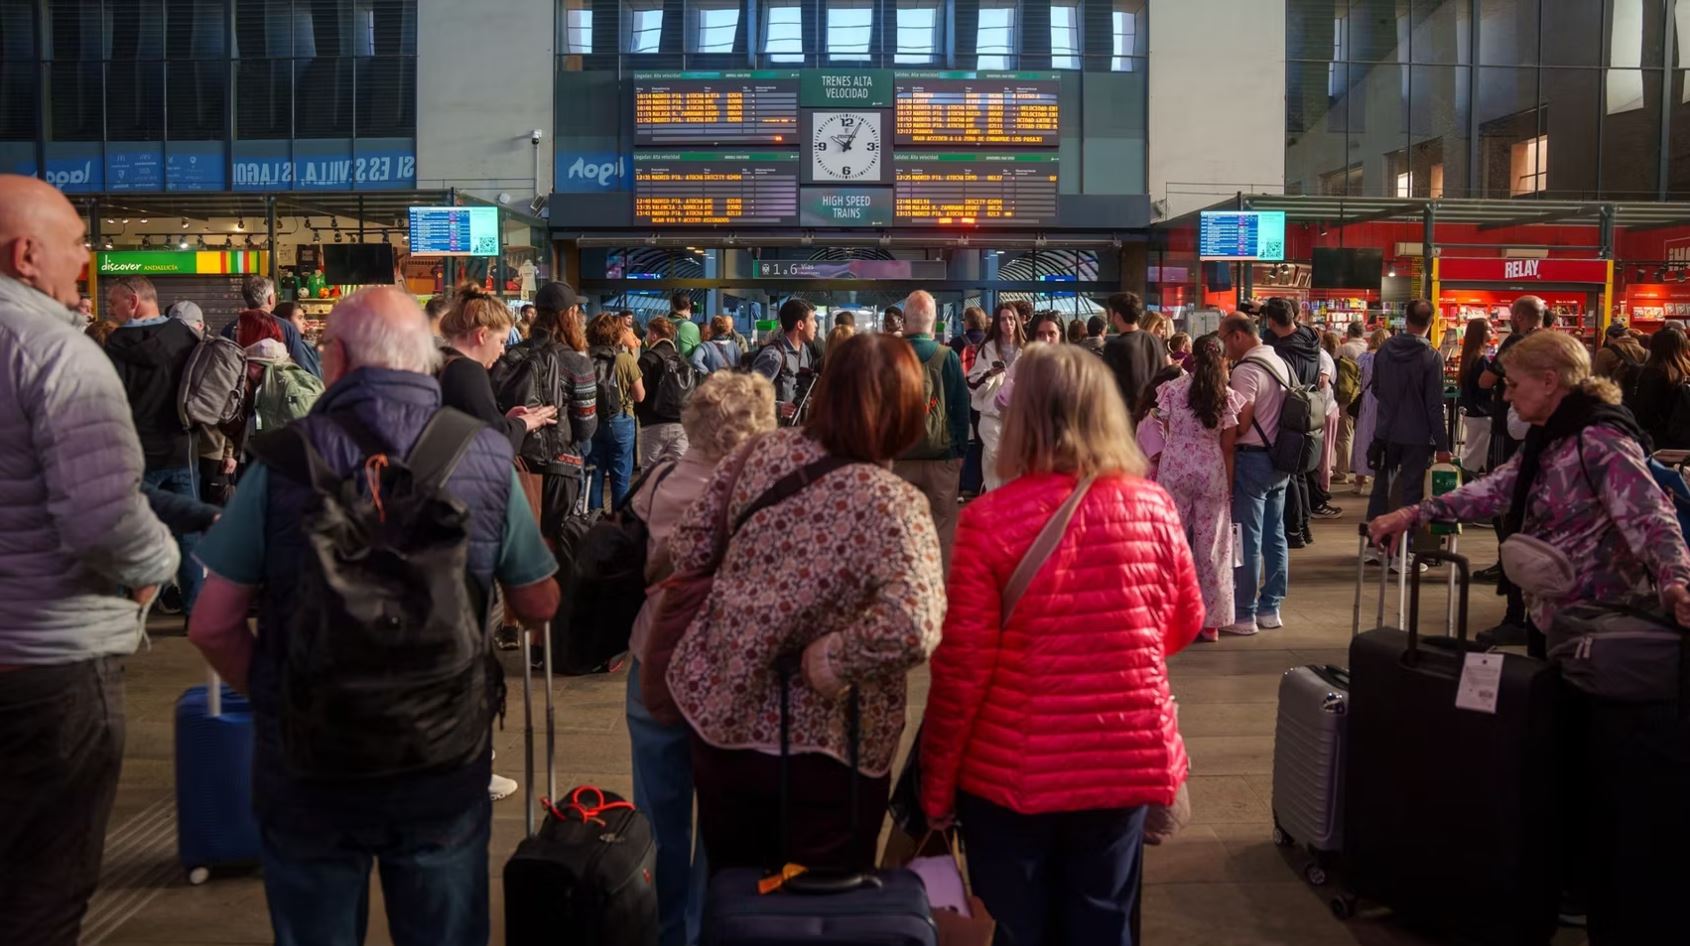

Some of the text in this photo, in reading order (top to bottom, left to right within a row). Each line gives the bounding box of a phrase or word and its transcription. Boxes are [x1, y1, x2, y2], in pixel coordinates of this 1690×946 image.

[822, 76, 872, 86] TRENES ALTA
[826, 88, 868, 98] VELOCIDAD
[840, 118, 854, 127] 12
[818, 142, 827, 152] 9
[866, 142, 876, 152] 3
[842, 166, 851, 176] 6
[822, 195, 871, 206] HIGH SPEED
[833, 208, 860, 219] TRAINS
[101, 254, 142, 272] discover
[773, 264, 780, 275] 1
[790, 264, 797, 275] 6
[1504, 260, 1539, 278] RELAY
